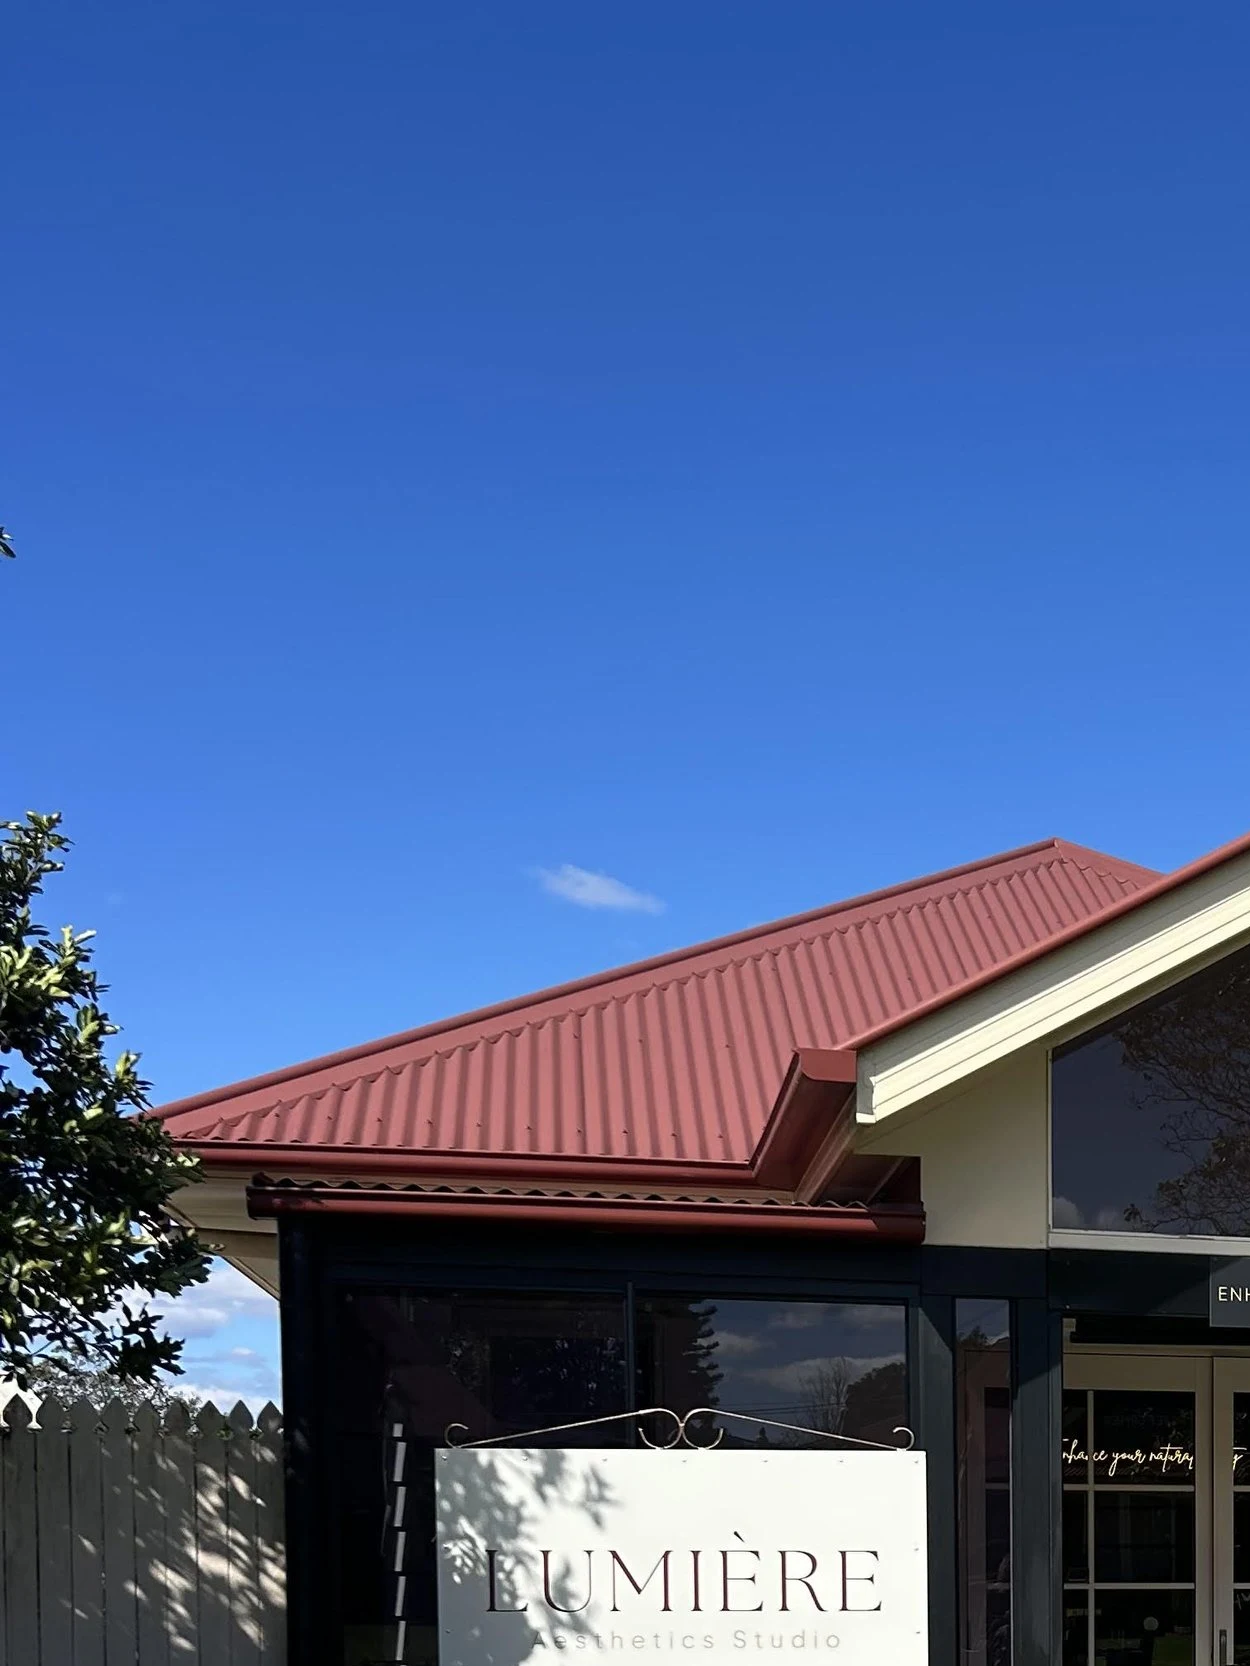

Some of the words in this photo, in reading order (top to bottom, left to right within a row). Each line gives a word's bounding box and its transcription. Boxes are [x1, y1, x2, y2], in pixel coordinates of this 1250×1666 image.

[1112, 1449, 1146, 1476] your
[486, 1531, 882, 1614] LUMIÈRE
[531, 1629, 715, 1650] Aesthetics
[733, 1629, 841, 1650] Studio
